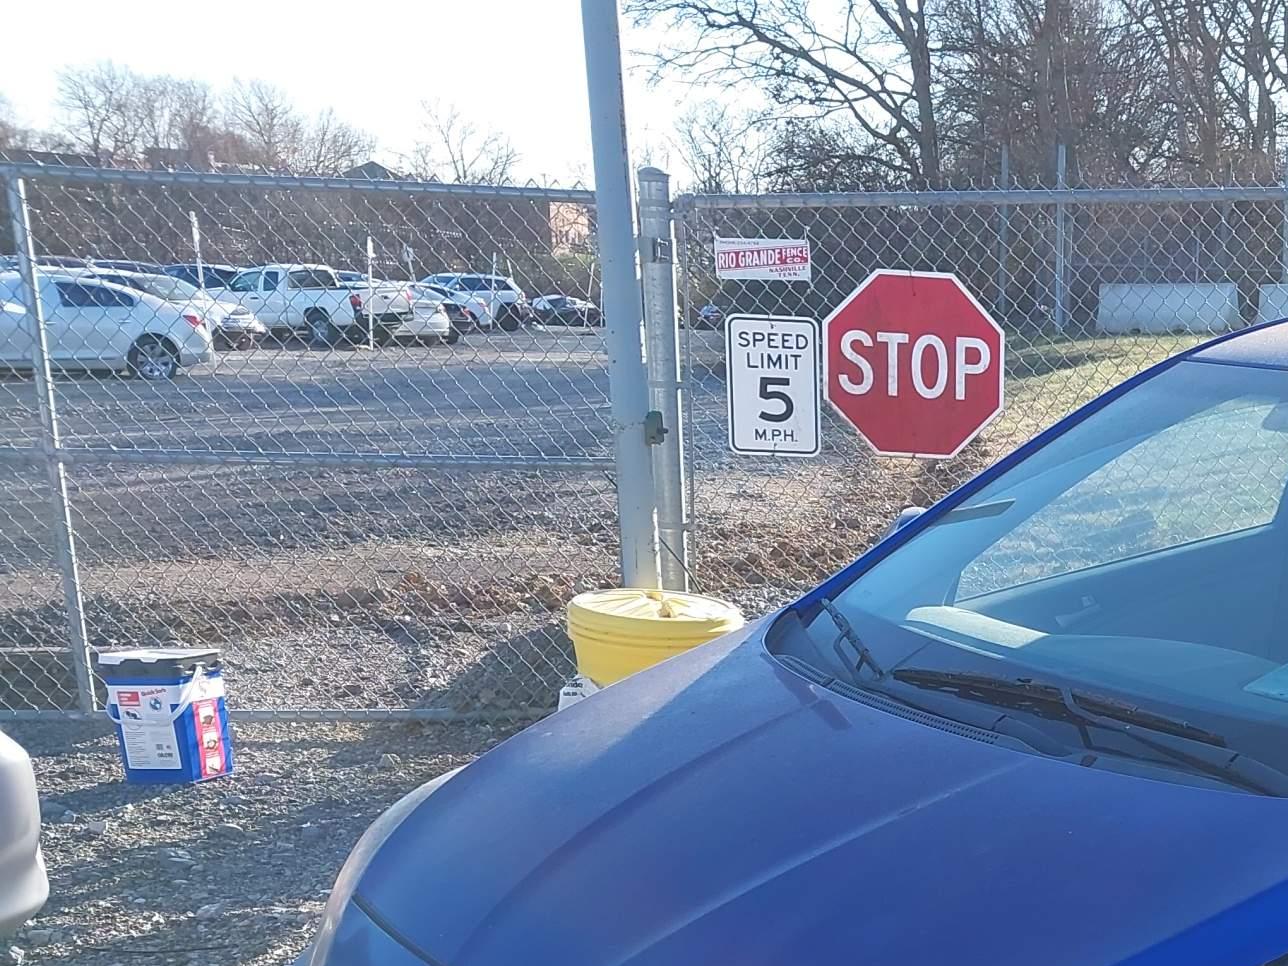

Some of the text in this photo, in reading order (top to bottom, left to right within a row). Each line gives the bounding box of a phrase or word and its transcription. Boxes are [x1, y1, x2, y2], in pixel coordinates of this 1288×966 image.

[718, 248, 781, 269] RIO GRANDE
[782, 247, 808, 259] FENCE
[768, 265, 807, 273] NASHVILLE
[737, 330, 809, 350] SPEED
[746, 352, 803, 371] LIMIT
[837, 329, 991, 401] STOP
[758, 377, 794, 423] 5
[754, 428, 798, 443] M.P.H.
